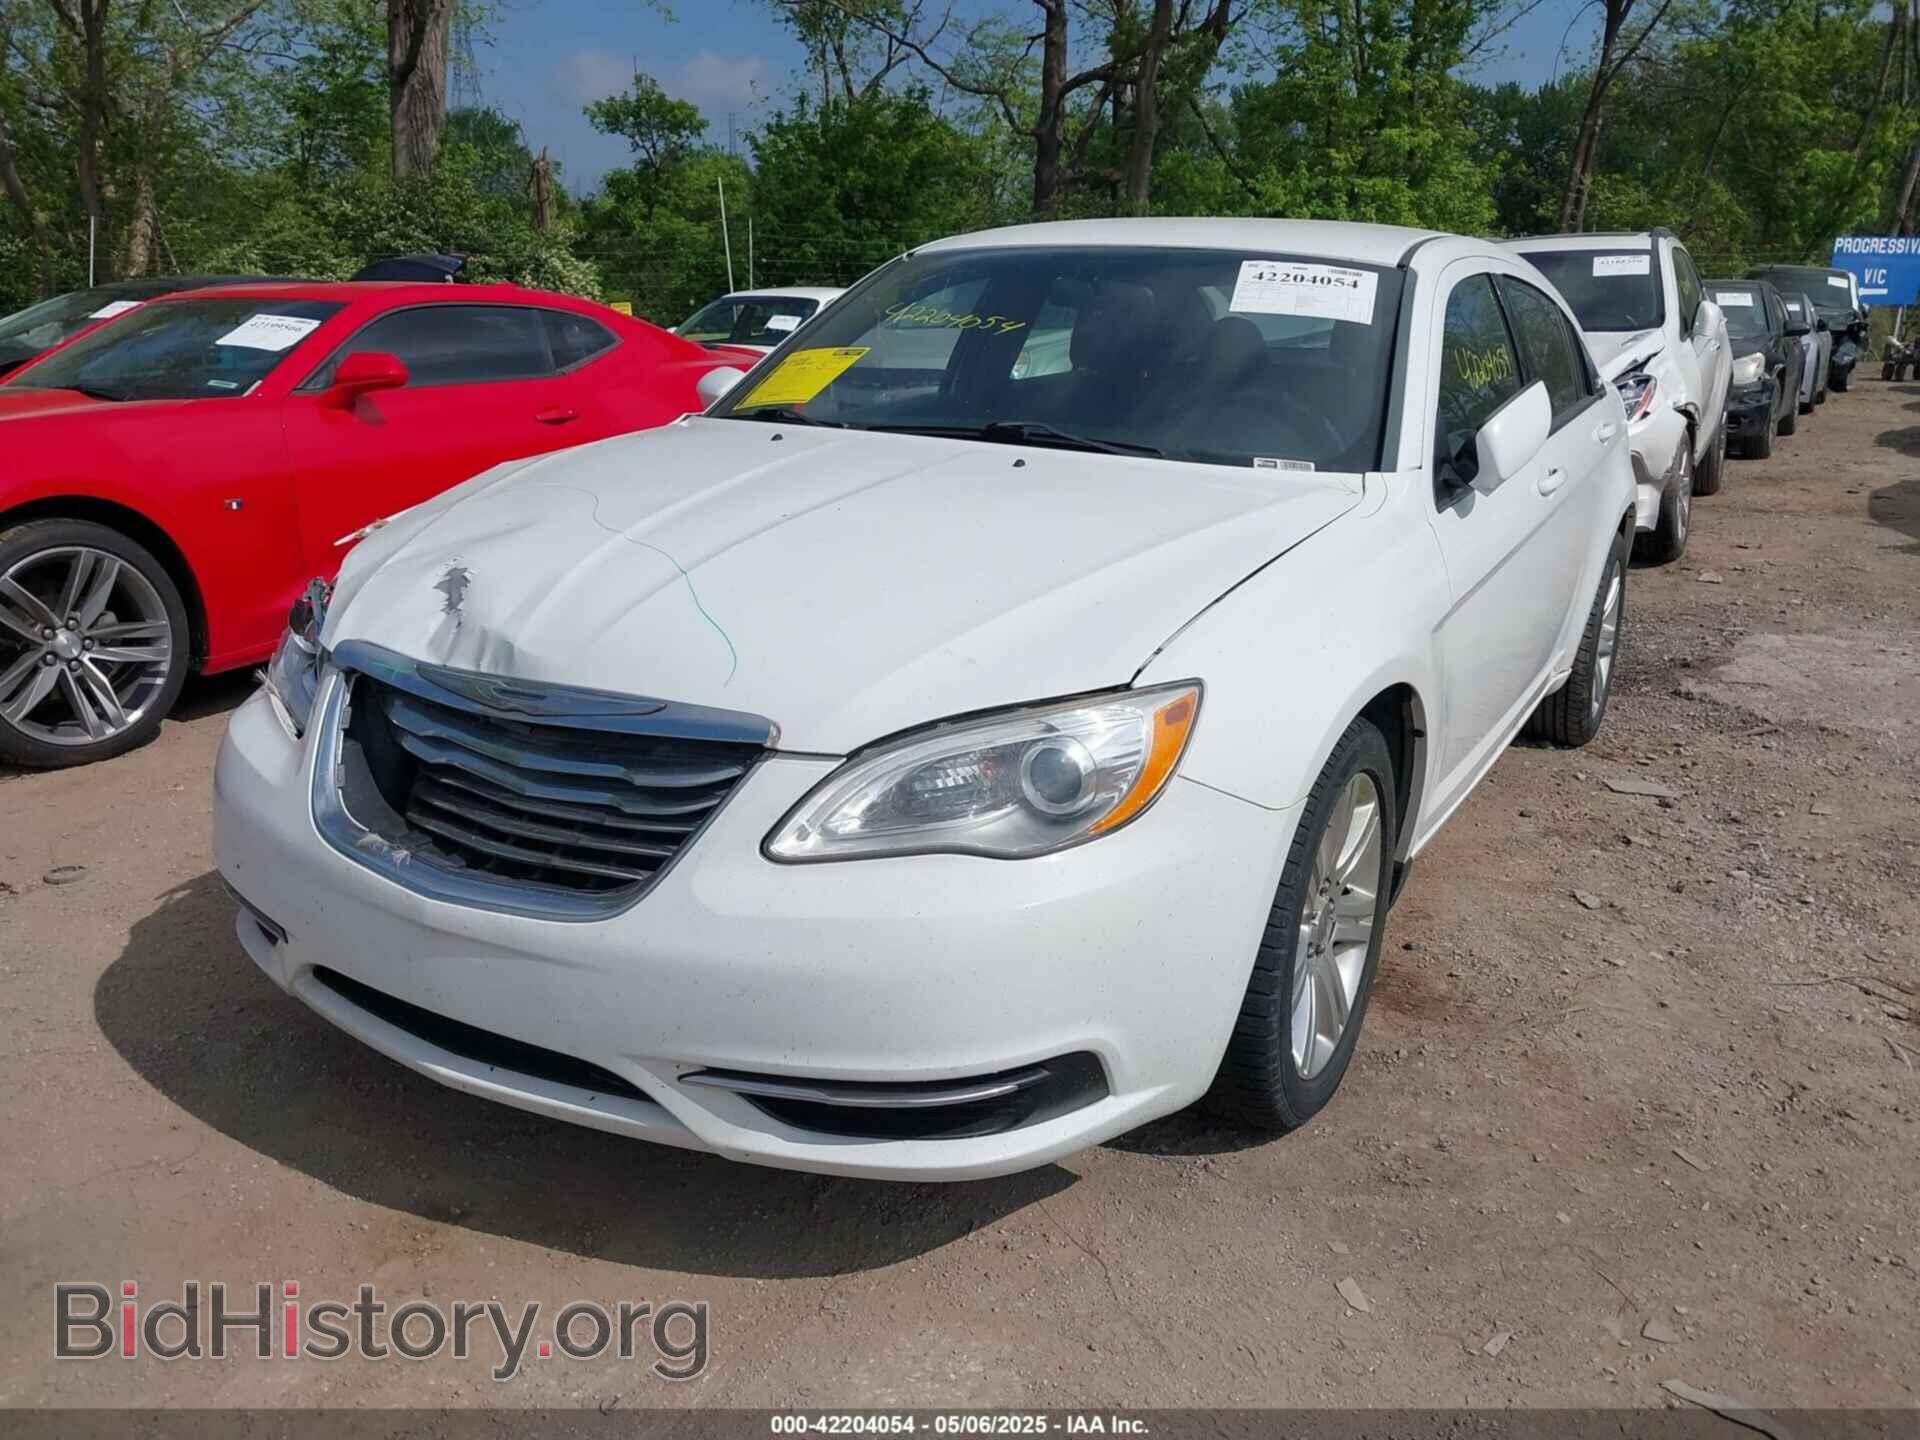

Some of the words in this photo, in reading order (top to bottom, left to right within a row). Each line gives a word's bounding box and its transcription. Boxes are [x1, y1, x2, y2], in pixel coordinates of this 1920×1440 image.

[1834, 237, 1920, 254] PROGRESSIV
[1251, 271, 1359, 289] 42204054
[1864, 268, 1887, 284] VIC
